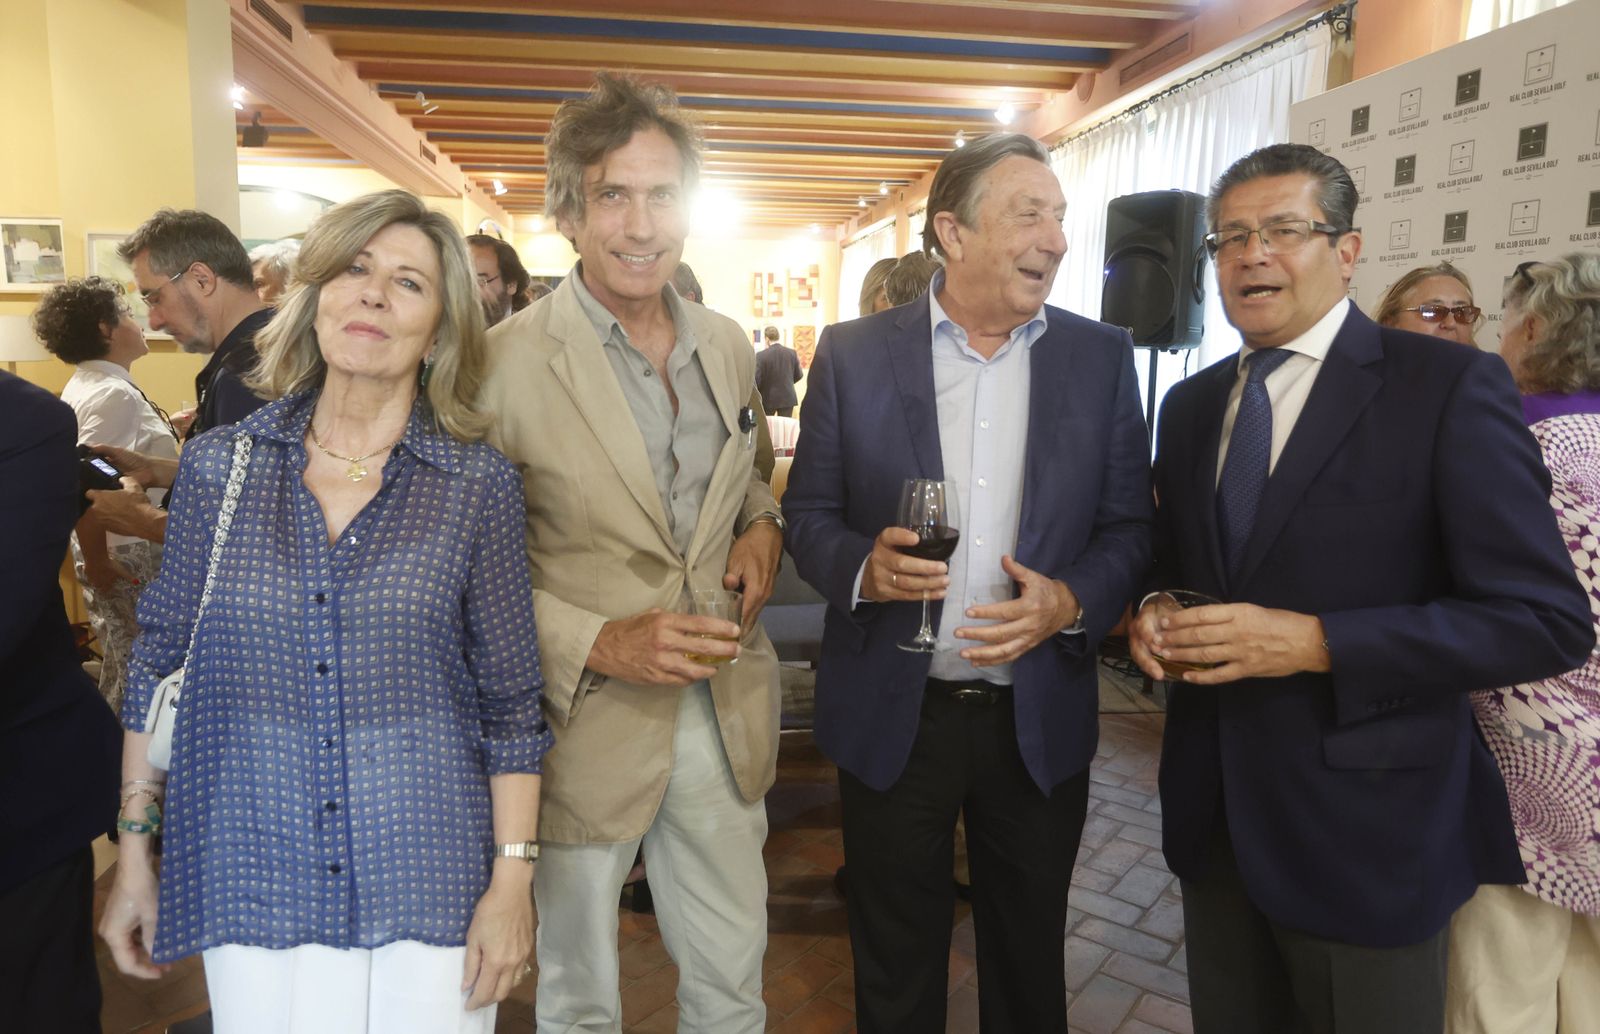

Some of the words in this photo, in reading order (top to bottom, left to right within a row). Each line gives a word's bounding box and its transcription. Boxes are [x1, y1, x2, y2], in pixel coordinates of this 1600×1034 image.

[1509, 93, 1521, 102] REAL
[1521, 90, 1533, 100] CLUB
[1534, 84, 1553, 96] SEVILLA
[1554, 80, 1566, 91] GOLF
[1442, 112, 1452, 120] REAL
[1453, 110, 1462, 118] CLUB
[1464, 104, 1479, 116] SEVILLA
[1480, 102, 1490, 111] GOLF
[1397, 126, 1406, 134] CLUB
[1406, 121, 1420, 132] SEVILLA
[1578, 153, 1590, 162] REAL
[1502, 168, 1514, 176] REAL
[1514, 166, 1526, 174] CLUB
[1526, 162, 1546, 172] SEVILLA
[1546, 160, 1558, 168] GOLF
[1447, 180, 1456, 188] CLUB
[1457, 176, 1472, 186] SEVILLA
[1473, 174, 1482, 182] GOLF
[1402, 188, 1414, 196] SEVILLA
[1506, 240, 1518, 249] CLUB
[1519, 238, 1538, 248] SEVILLA
[1538, 236, 1550, 246] GOLF
[1570, 233, 1582, 242] REAL
[1583, 232, 1597, 240] CLUB
[1396, 252, 1410, 261] SEVILLA
[1441, 248, 1450, 256] CLUB
[1450, 246, 1466, 255] SEVILLA
[1466, 244, 1476, 253] GOLF
